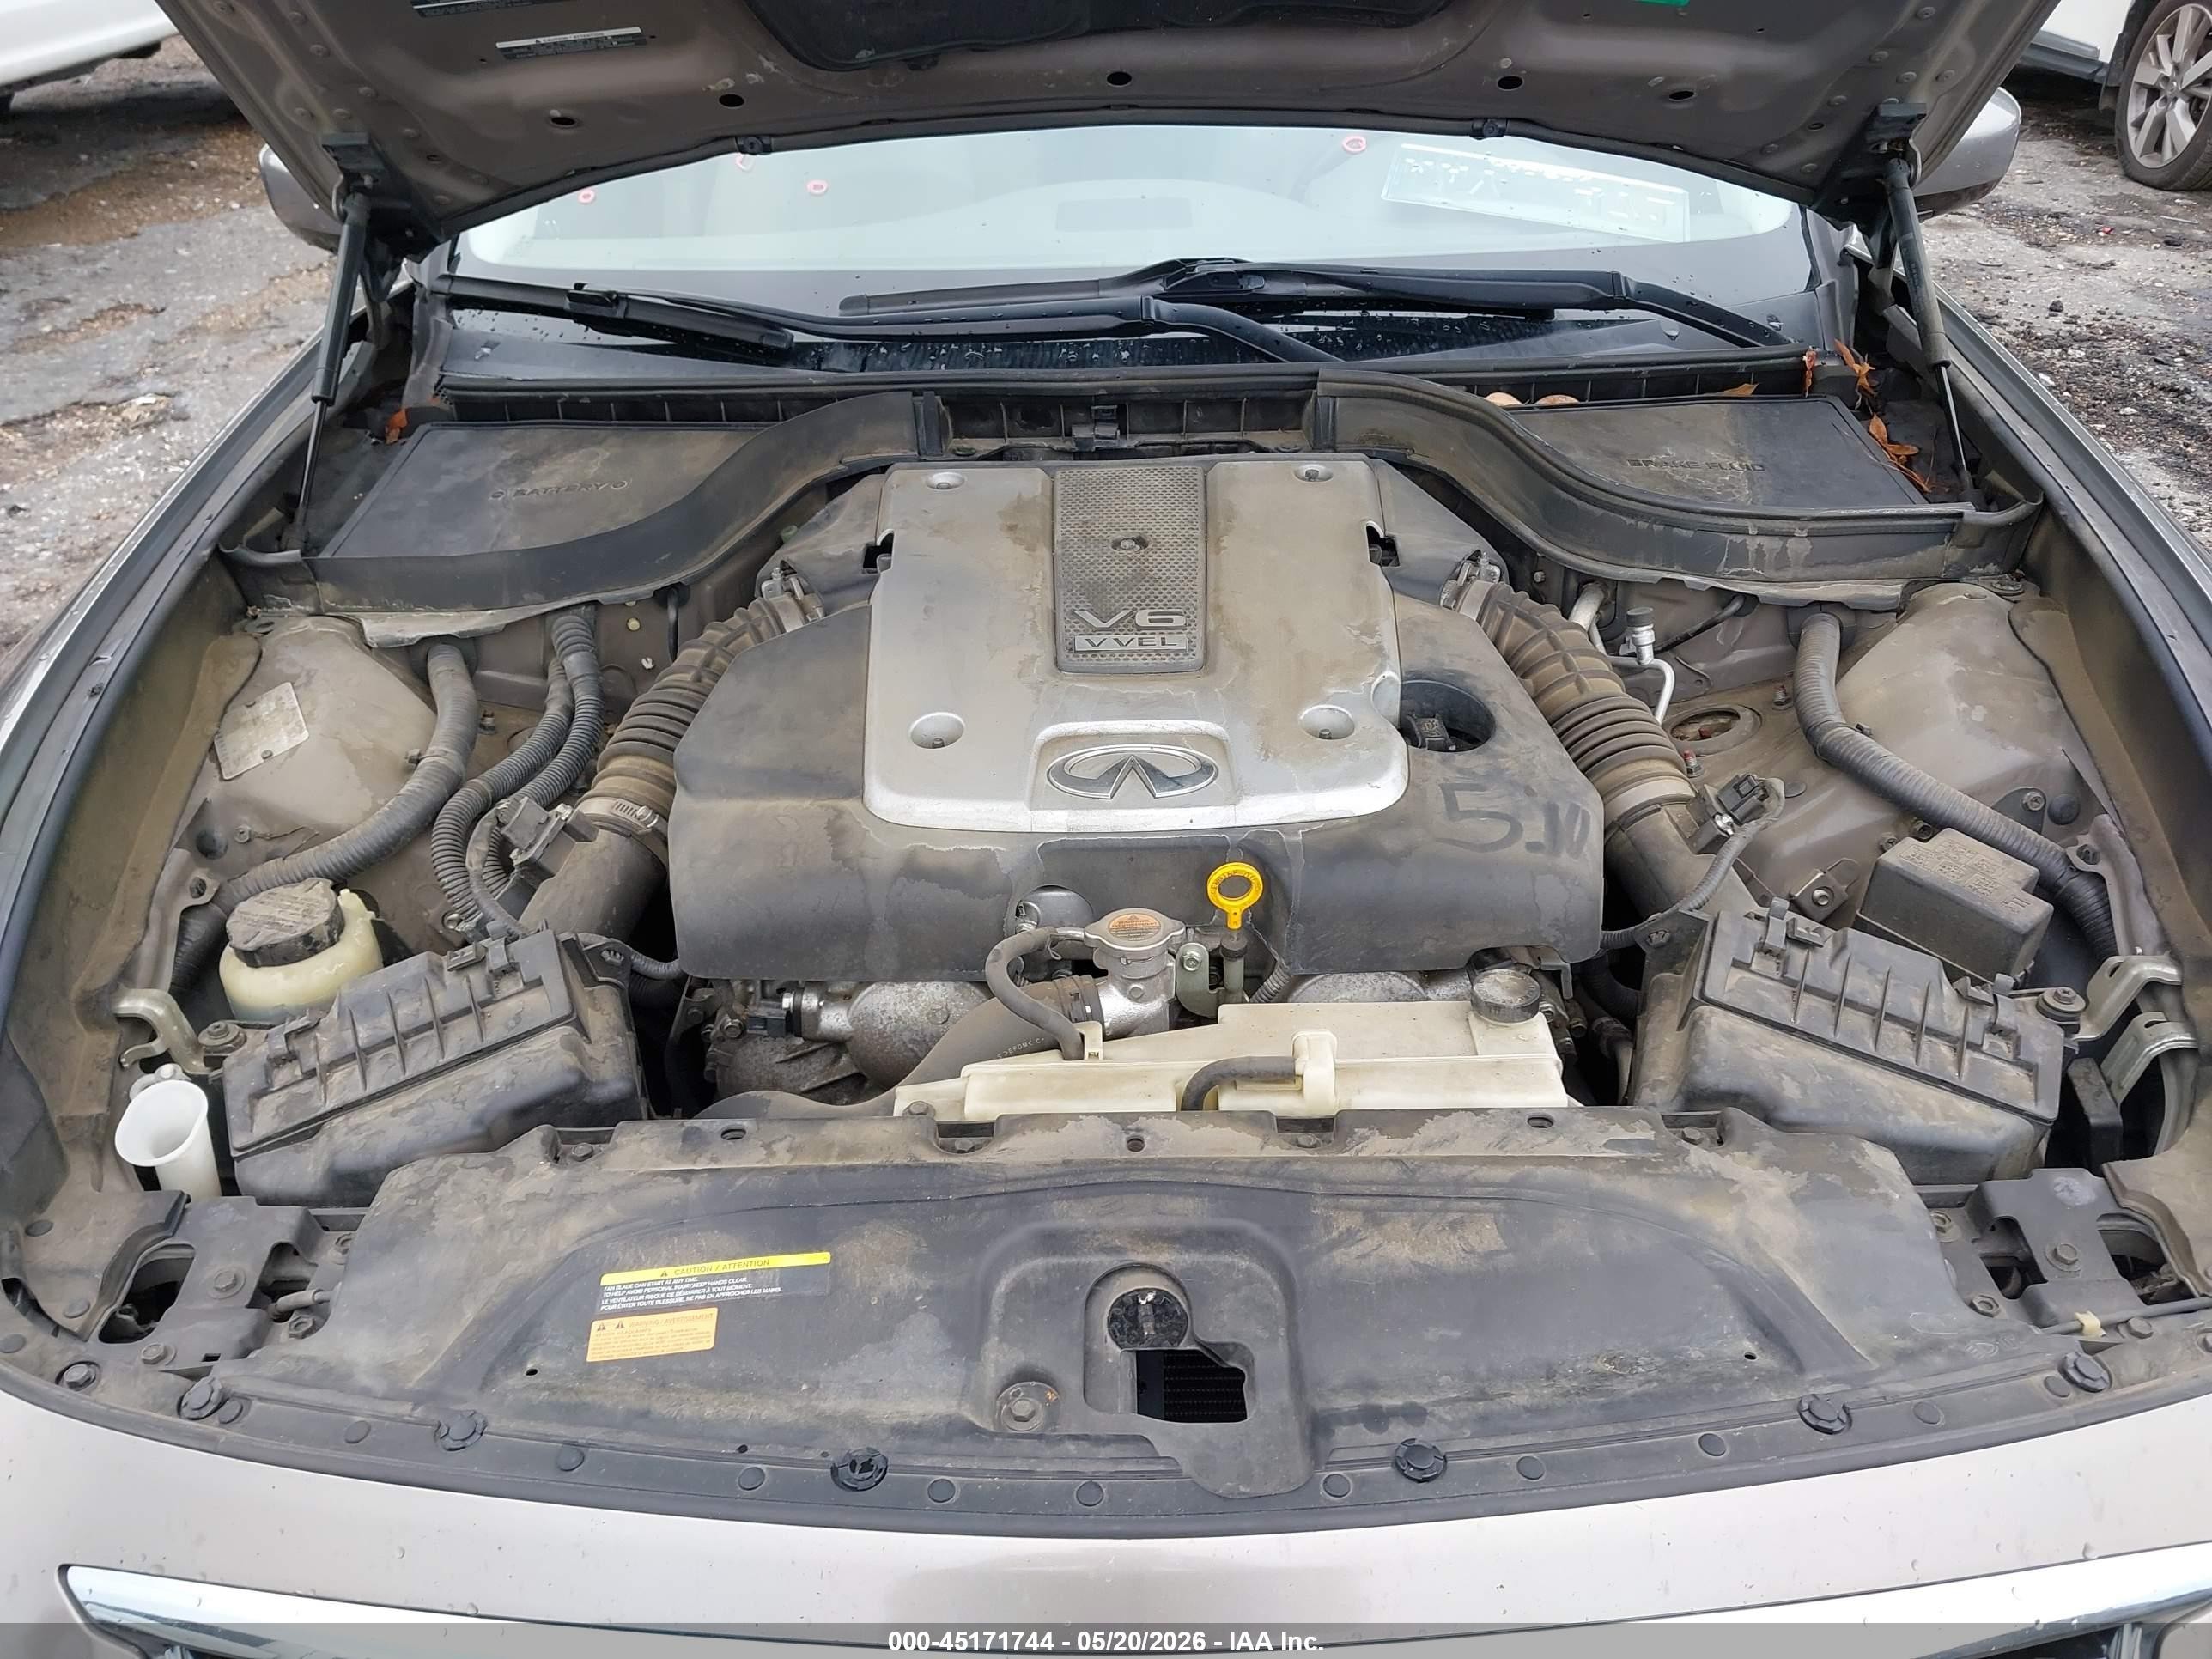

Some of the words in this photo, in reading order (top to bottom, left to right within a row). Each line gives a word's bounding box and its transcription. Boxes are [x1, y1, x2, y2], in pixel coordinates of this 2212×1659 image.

[1627, 459, 1703, 470] BRAKE
[1705, 461, 1766, 471] FLUID
[513, 482, 609, 497] BATTERY
[1073, 609, 1188, 629] V6
[1084, 636, 1178, 647] VVEL
[673, 1265, 714, 1277] CAUTION
[721, 1259, 770, 1271] ATTENTION
